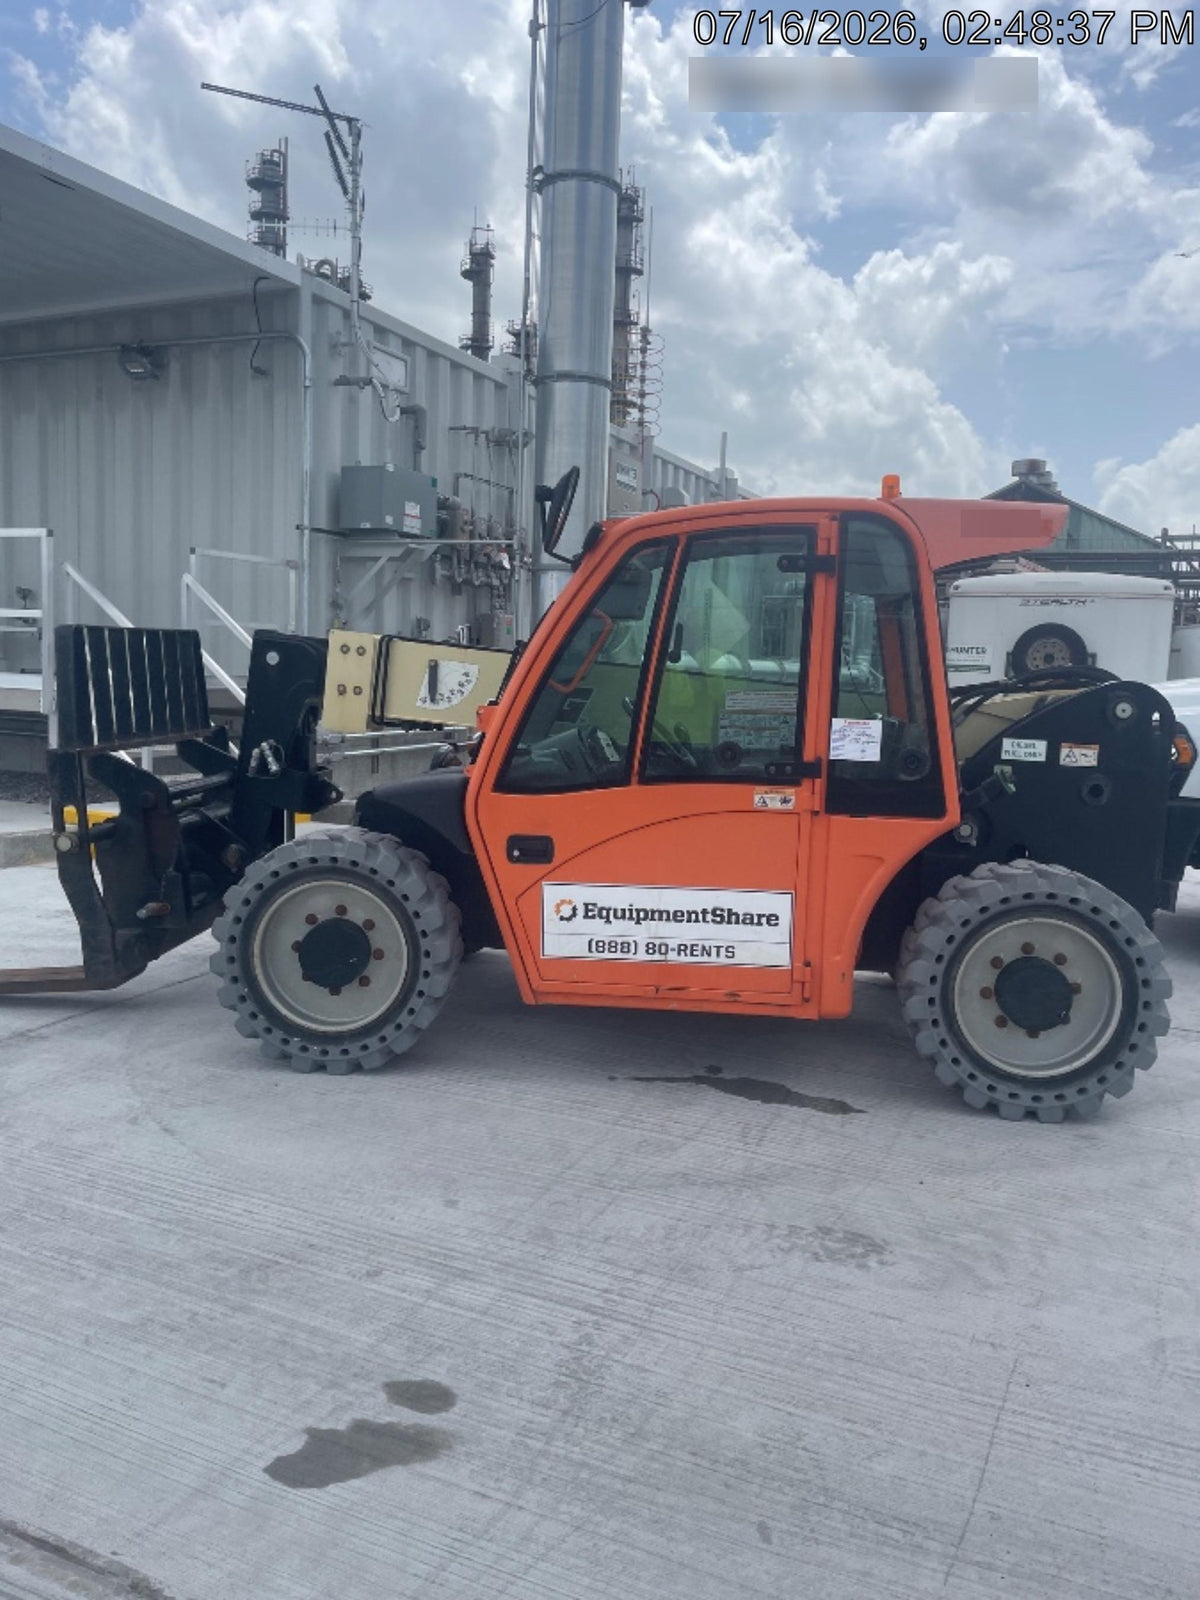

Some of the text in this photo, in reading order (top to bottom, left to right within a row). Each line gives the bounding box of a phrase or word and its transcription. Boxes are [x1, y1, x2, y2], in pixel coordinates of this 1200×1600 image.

[582, 902, 780, 927] EquipmentShare
[587, 938, 736, 959] (888) 80-RENTS
